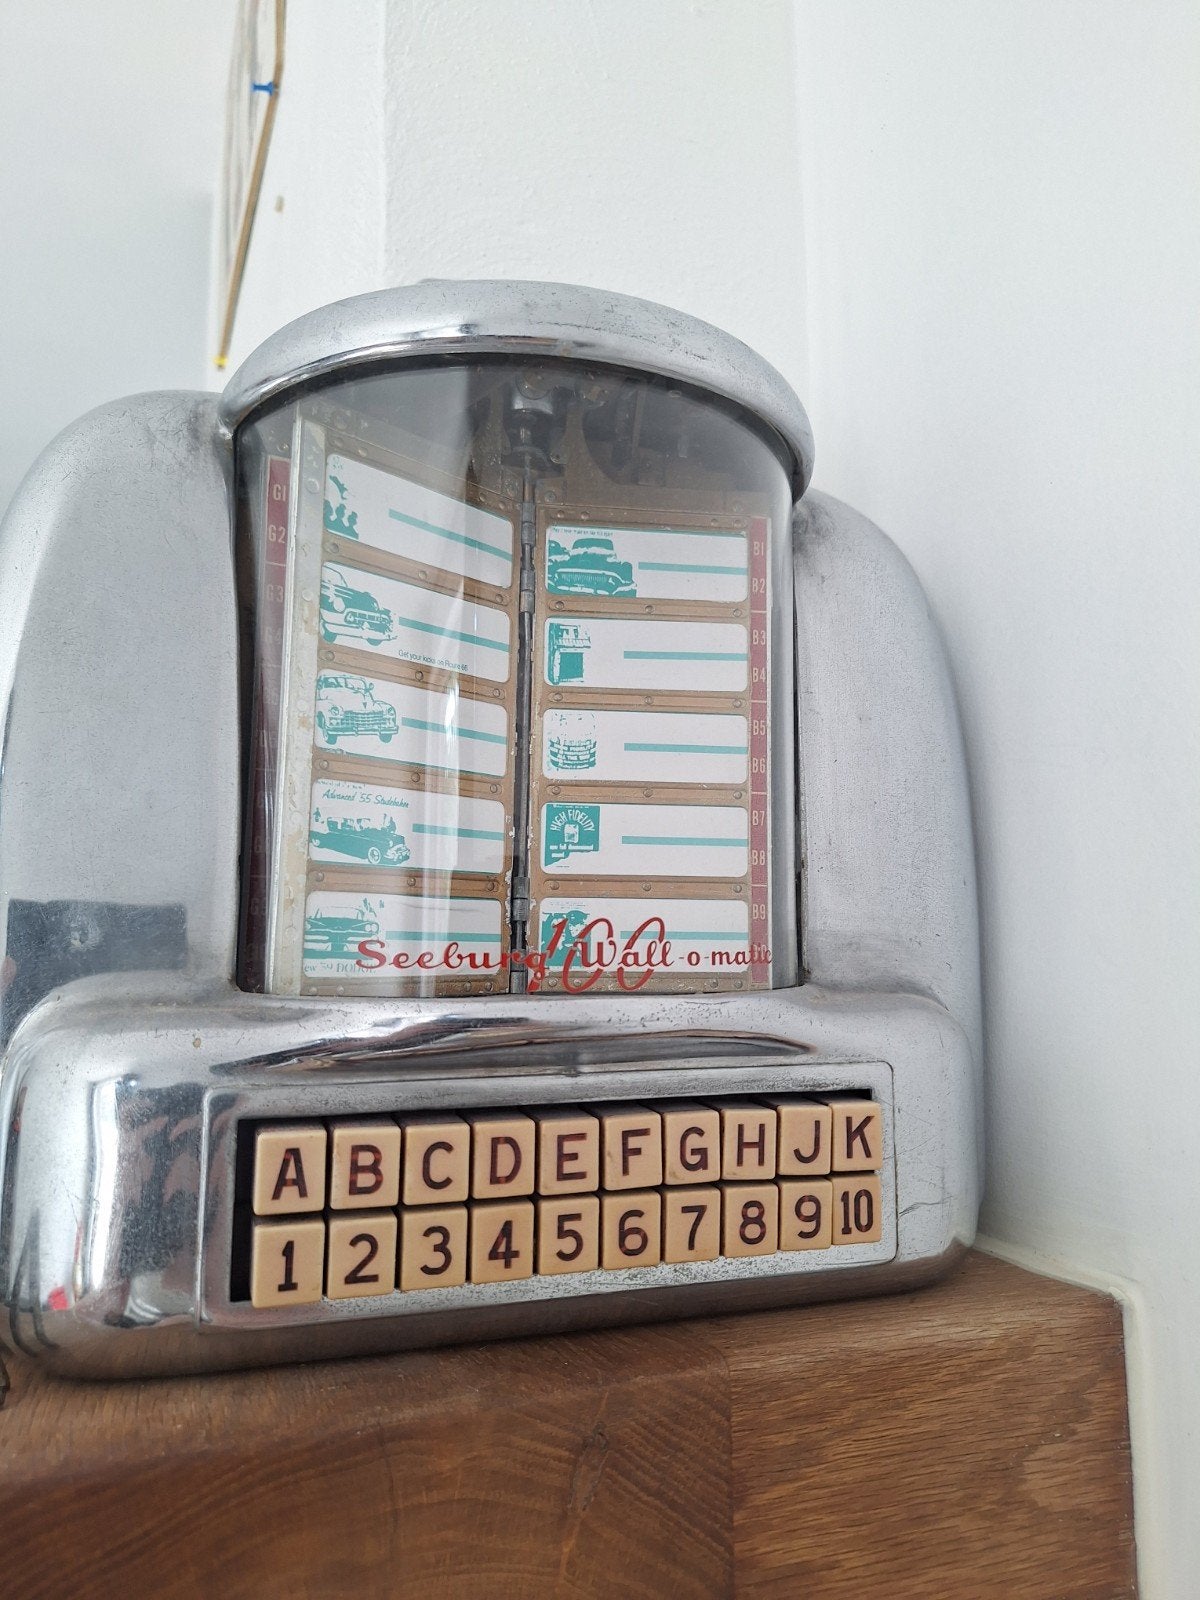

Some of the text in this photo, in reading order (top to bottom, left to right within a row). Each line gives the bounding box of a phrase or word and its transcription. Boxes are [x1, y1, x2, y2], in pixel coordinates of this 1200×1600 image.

[273, 484, 287, 501] G1
[268, 524, 286, 544] G2
[754, 542, 764, 556] B1
[267, 584, 284, 603] G3
[752, 578, 765, 593] B2
[752, 630, 766, 645] B3
[752, 667, 766, 683] B4
[753, 720, 766, 736] B5
[752, 758, 766, 774] B6
[549, 809, 596, 832] HIGH FIDELITY
[752, 810, 765, 826] B7
[751, 850, 765, 866] B8
[752, 904, 766, 920] B9
[356, 939, 550, 993] Seeburg
[272, 1116, 874, 1200] A B C D E F G H J K
[278, 1189, 873, 1292] 1 2 3 4 5 6 7 8 9 10
